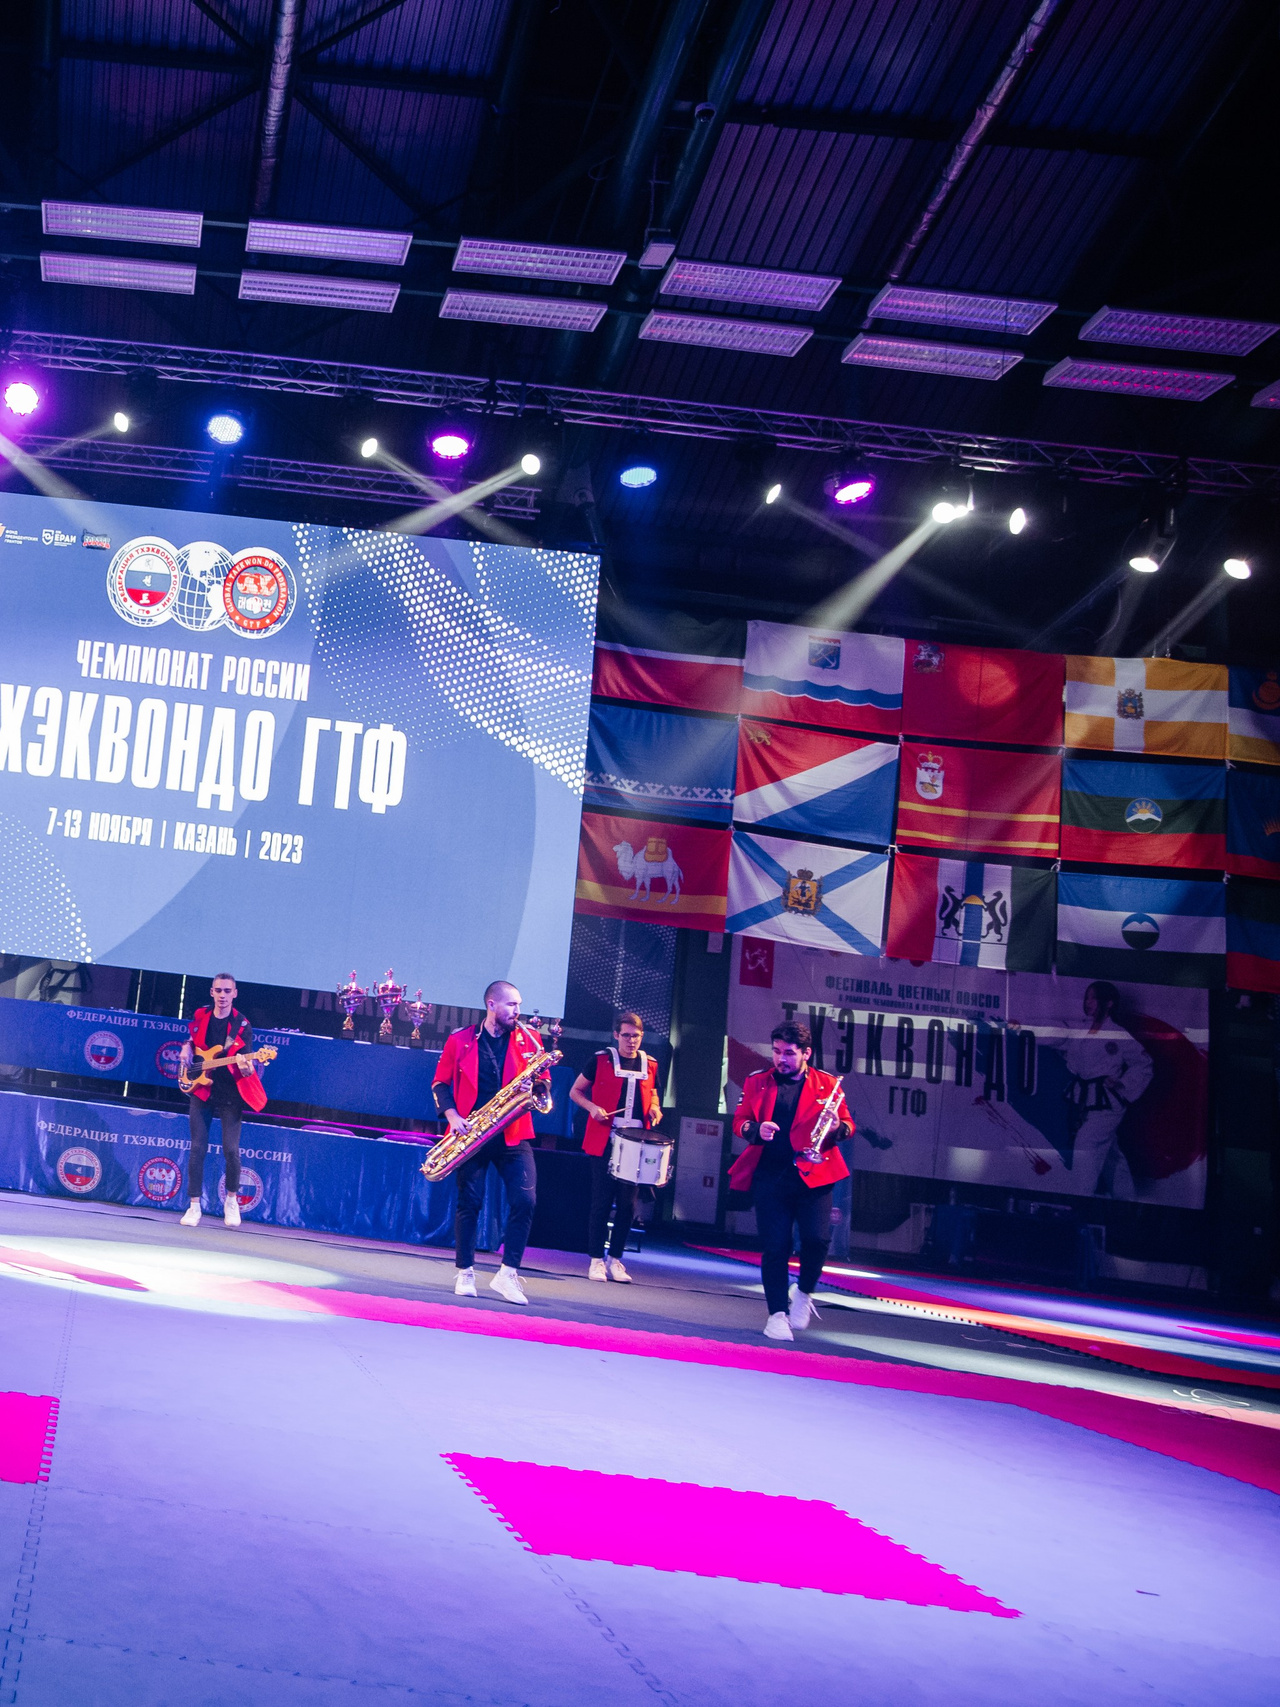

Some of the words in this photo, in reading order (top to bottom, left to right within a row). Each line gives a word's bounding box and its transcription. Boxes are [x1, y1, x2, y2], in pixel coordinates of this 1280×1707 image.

[117, 553, 135, 602] ФЕДЕРАЦИЯ
[135, 546, 176, 572] ТХЭКВОНДО
[161, 574, 178, 608] РОССИИ
[224, 581, 235, 613] GLOBAL
[273, 567, 287, 618] FEDERATION
[76, 639, 213, 691] ЧЕМПИОНАТ
[221, 655, 311, 702] РОССИИ
[298, 716, 408, 814] ГТФ
[46, 807, 83, 839] 7-13
[87, 811, 153, 847] НОЯБРЯ
[173, 821, 238, 856] КАЗАНЬ
[258, 831, 304, 864] 2023
[825, 975, 894, 996] ФЕСТИВАЛЬ
[898, 983, 952, 1003] ЦВЕТНЫХ
[956, 991, 1001, 1010] ПОЯСОВ
[66, 1009, 138, 1028] ФЕДЕРАЦИЯ
[251, 1033, 291, 1046] ОССИИ
[888, 1085, 928, 1118] ГТФ
[36, 1119, 119, 1144] ФЕДЕРАЦИЯ
[122, 1133, 192, 1151] ТХЭКВОНД
[239, 1147, 293, 1163] РОССИИ
